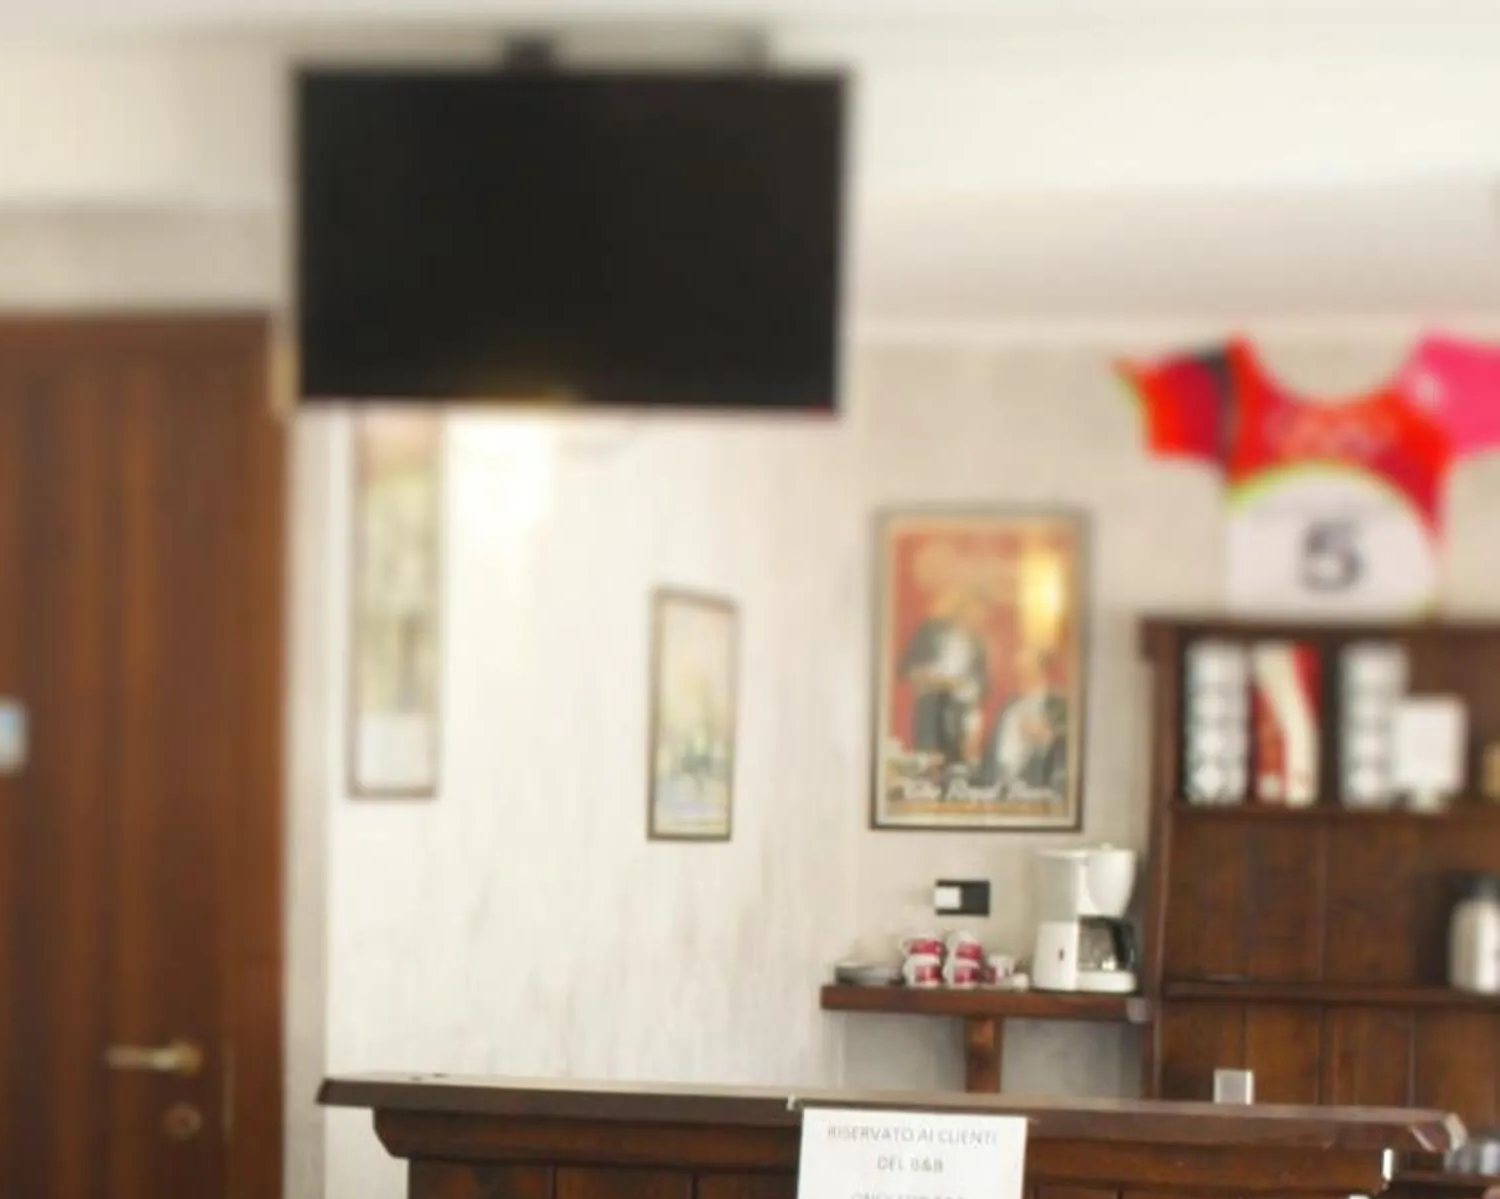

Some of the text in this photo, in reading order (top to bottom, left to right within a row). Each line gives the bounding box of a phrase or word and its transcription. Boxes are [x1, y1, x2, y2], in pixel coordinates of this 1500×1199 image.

[1300, 519, 1364, 595] 5
[827, 1125, 999, 1146] RISERVATO AI CLIENTI
[877, 1155, 944, 1174] DEL B&B
